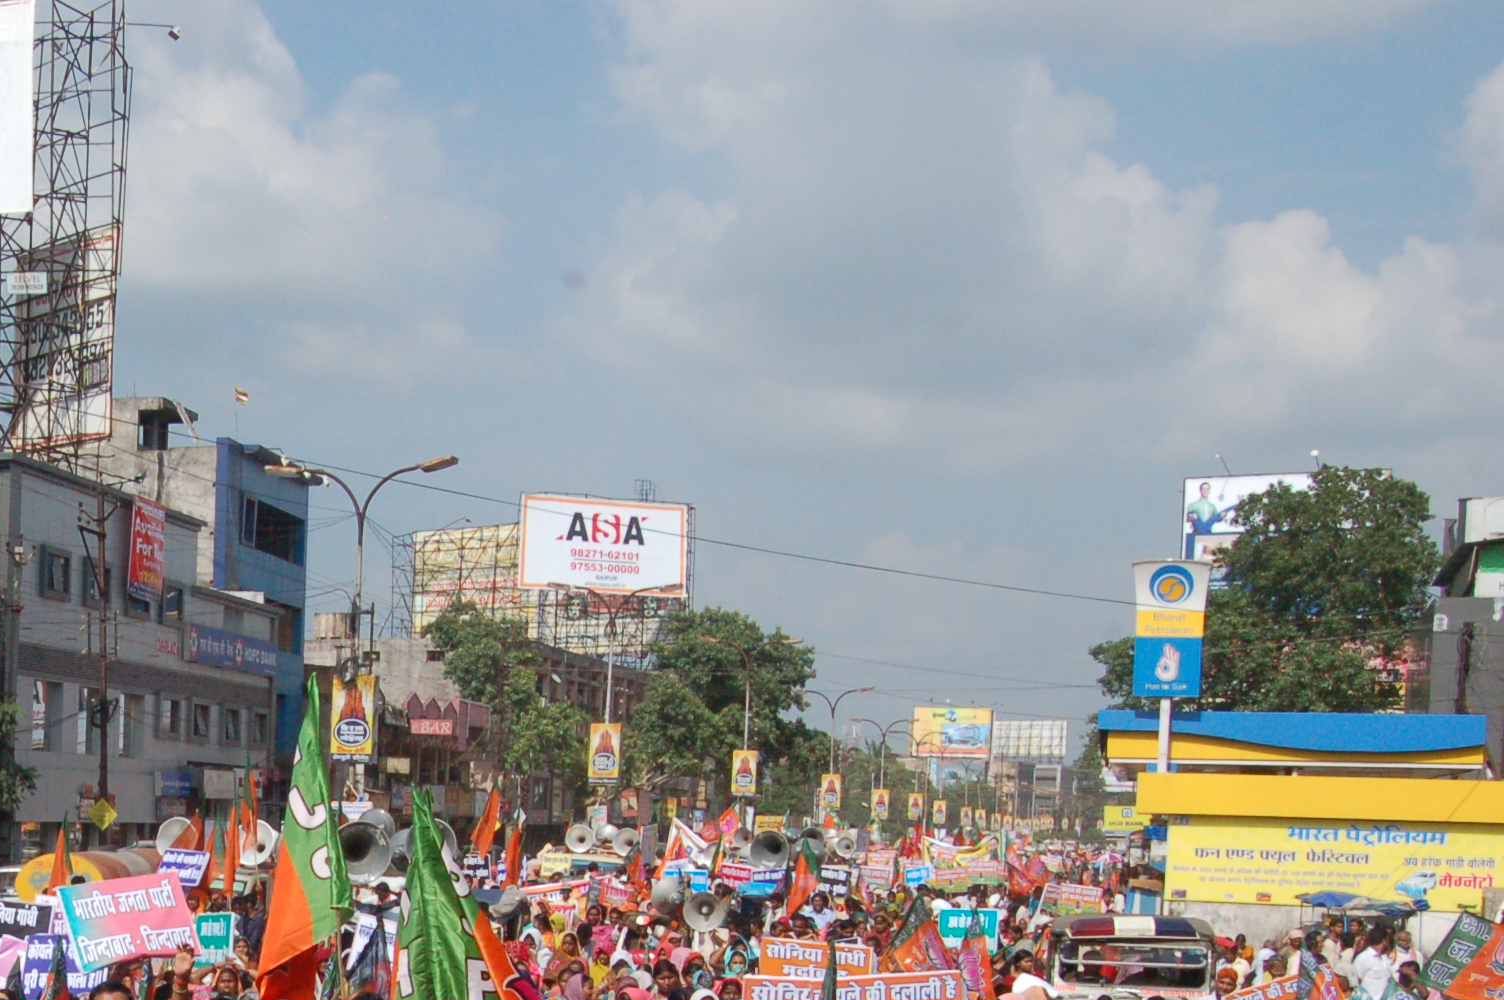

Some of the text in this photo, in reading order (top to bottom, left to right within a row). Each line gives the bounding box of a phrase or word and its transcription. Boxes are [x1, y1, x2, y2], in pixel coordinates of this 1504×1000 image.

[566, 512, 645, 546] ASA
[136, 538, 153, 556] For
[571, 549, 639, 561] 98271-62101
[571, 561, 640, 574] 97553-00000
[1154, 613, 1186, 622] Bharat
[1145, 625, 1193, 634] Petroleum
[245, 646, 277, 666] HDFC BANK
[421, 721, 451, 733] BAR
[1287, 823, 1447, 847] भारत पेट्रोलियम
[1195, 847, 1369, 865] फन एण्ड फ्यूल फेस्टिवल
[1403, 856, 1495, 869] अब हरेक गाड़ी बोलेगी
[74, 878, 176, 920] भारतीय जनता पार्टी
[16, 903, 39, 927] गांधी
[27, 938, 53, 961] कोयले
[78, 925, 195, 965] जिन्दाबाद जिन्दाबाद
[765, 941, 823, 962] सोनिया
[1427, 913, 1491, 986] भा. ज. पा.
[24, 969, 40, 995] पूरी
[890, 977, 941, 1000] दलाली
[942, 975, 957, 999] है
